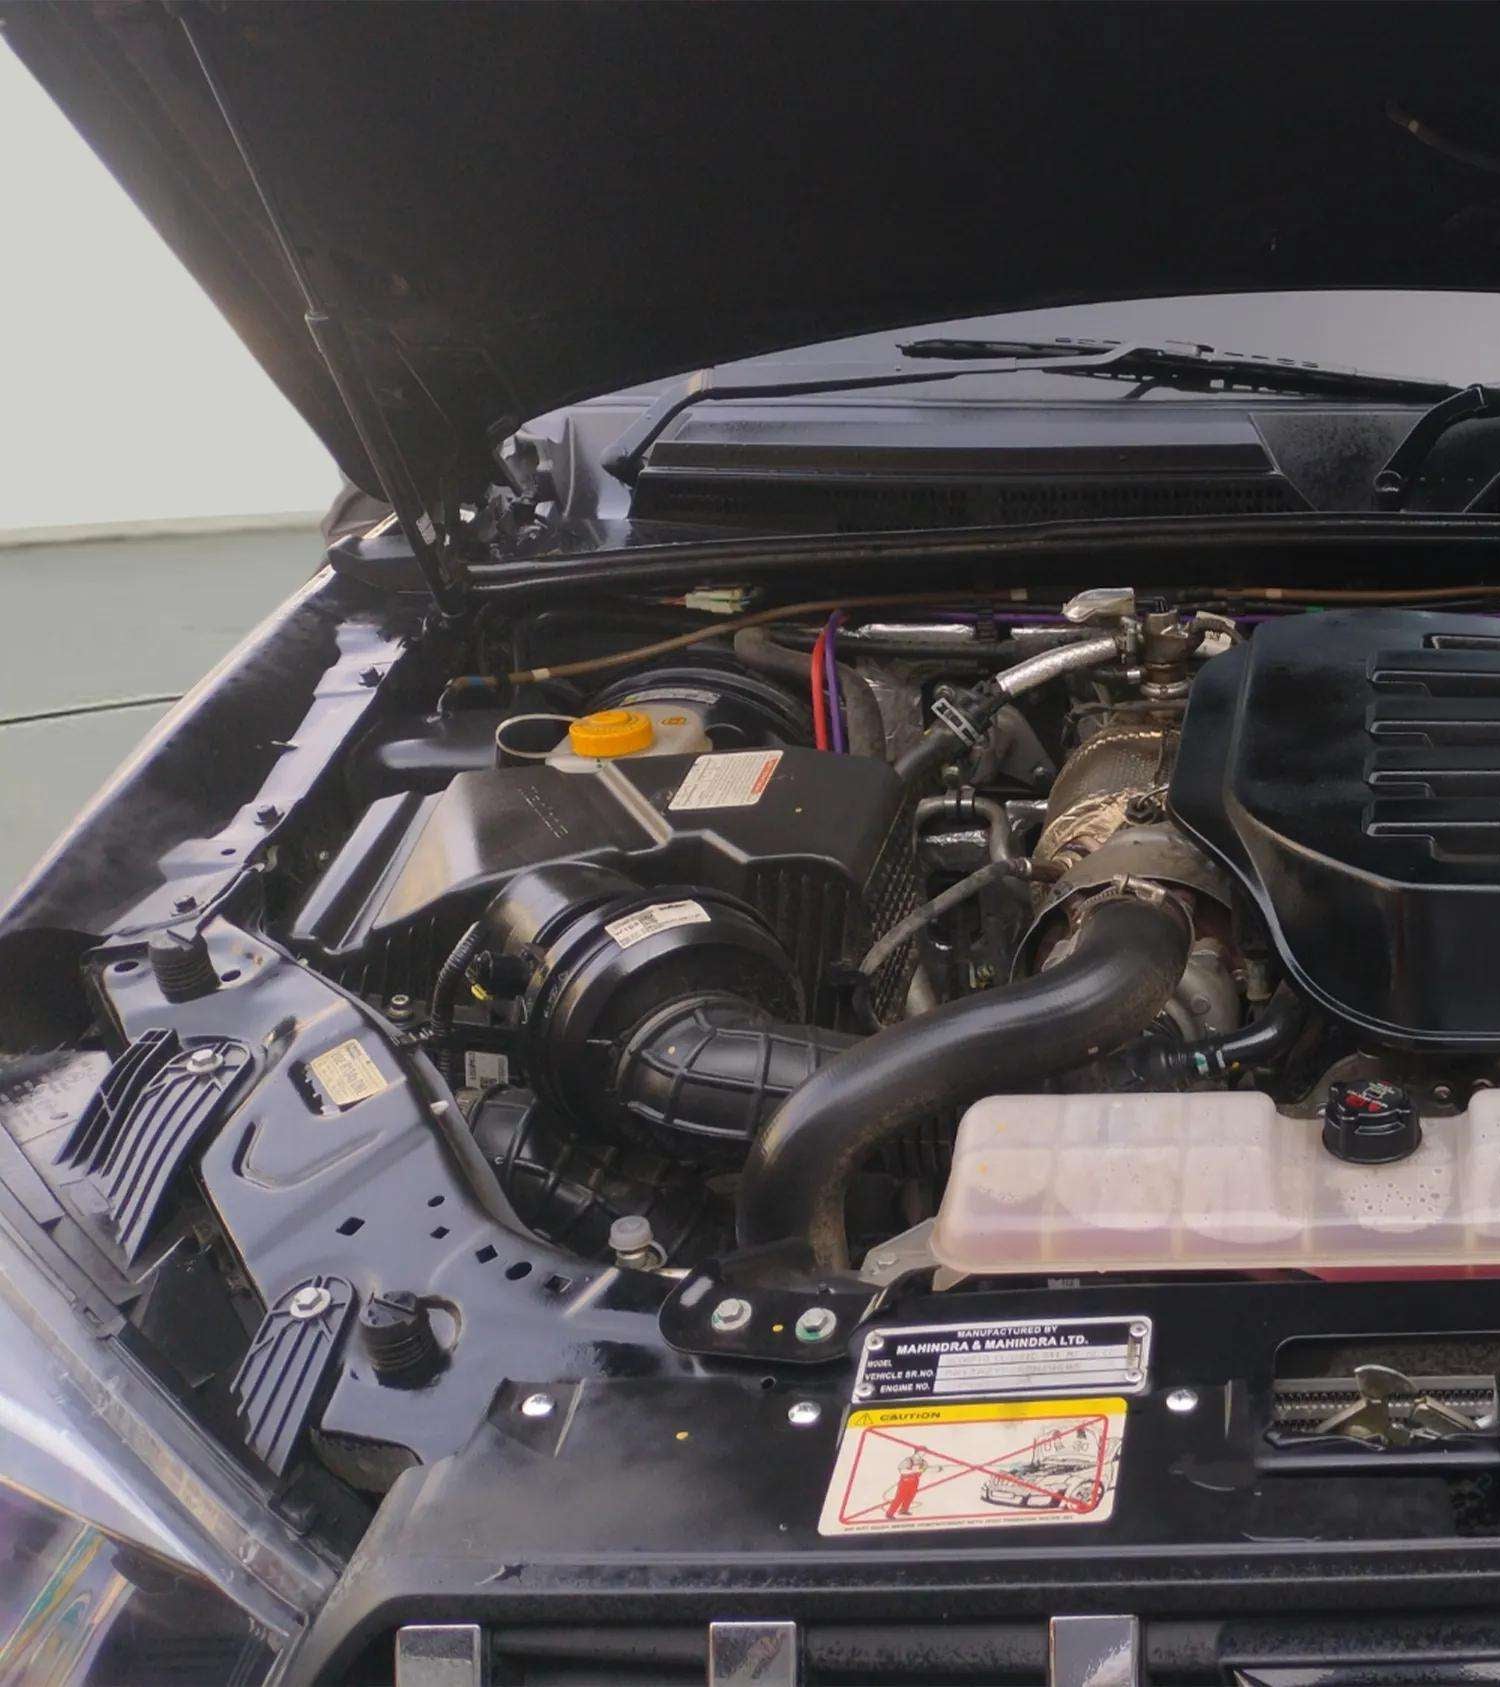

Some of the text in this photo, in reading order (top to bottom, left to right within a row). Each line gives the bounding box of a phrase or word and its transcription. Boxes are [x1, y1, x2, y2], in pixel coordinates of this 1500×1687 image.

[957, 1325, 1058, 1338] MANUFACTURED BY
[896, 1341, 969, 1356] MAHINDRA
[972, 1340, 981, 1351] &
[984, 1336, 1057, 1350] MAHINDRA
[1059, 1335, 1089, 1346] LTD.
[867, 1359, 892, 1368] MODEL
[865, 1371, 902, 1381] VEHICLE
[880, 1382, 930, 1394] ENGINE NO.
[880, 1411, 941, 1421] CAUTION
